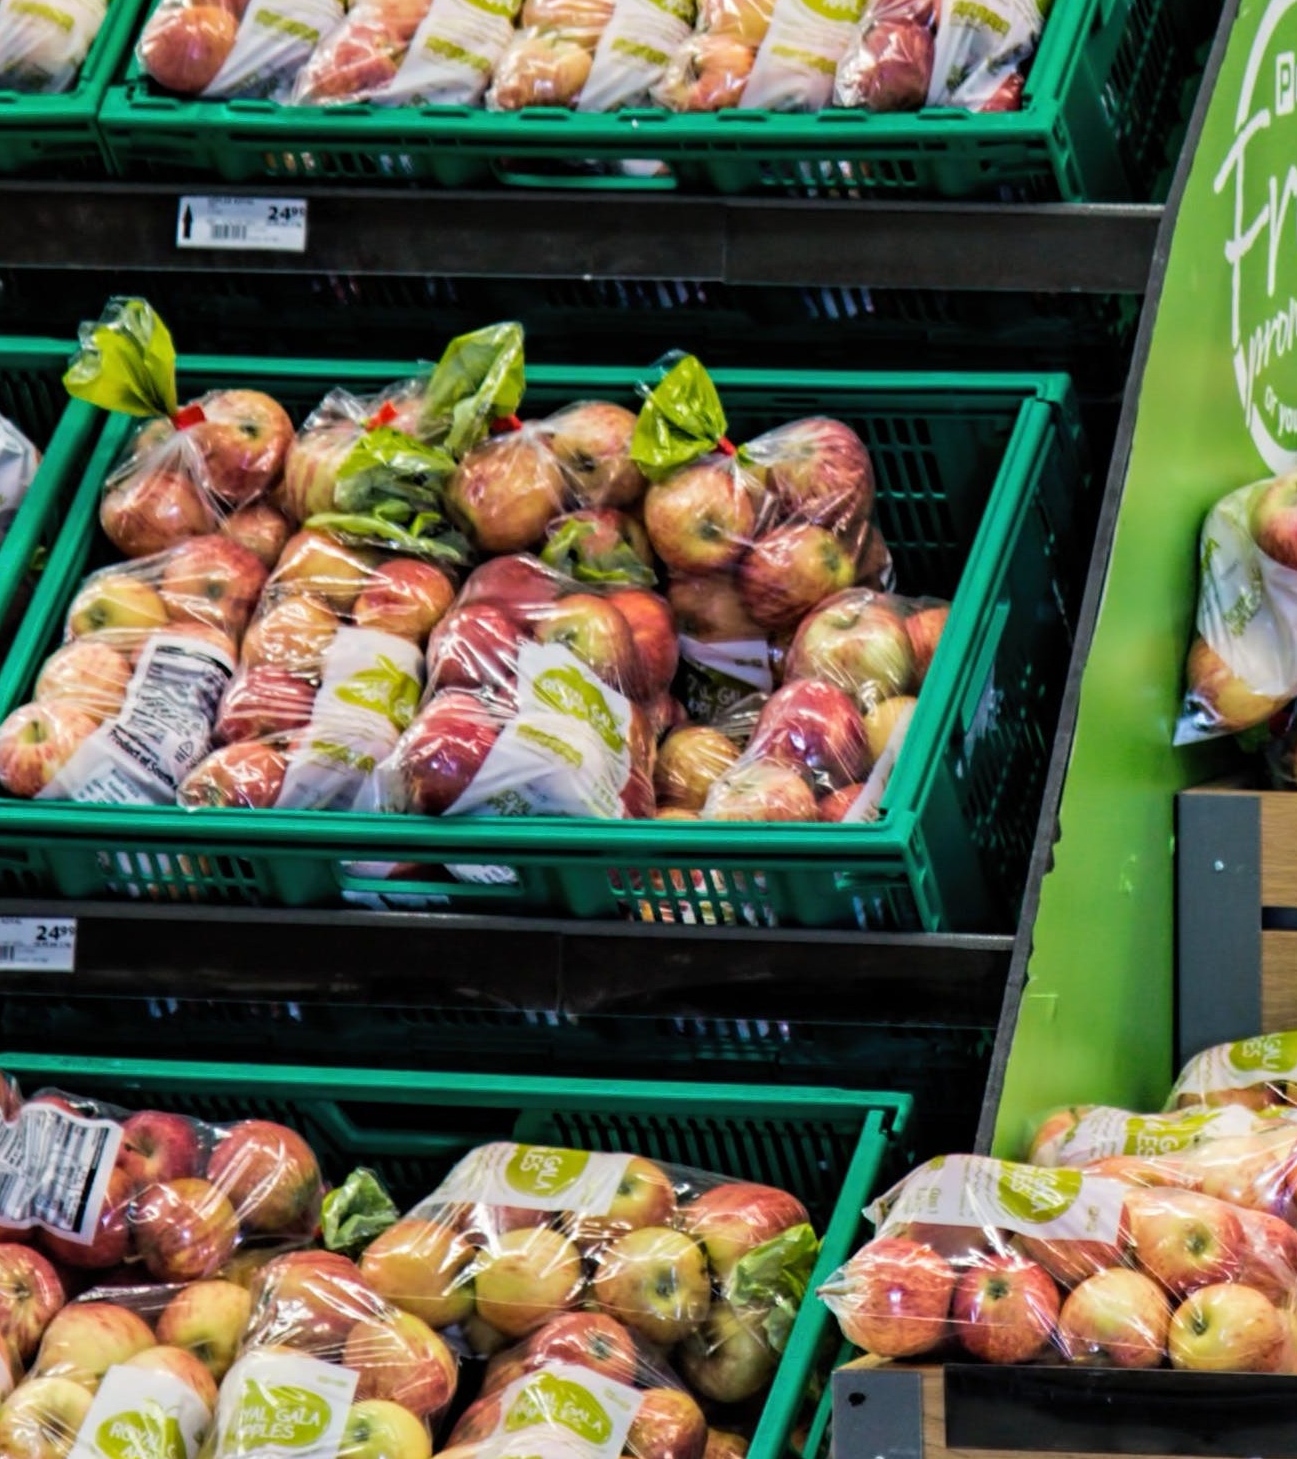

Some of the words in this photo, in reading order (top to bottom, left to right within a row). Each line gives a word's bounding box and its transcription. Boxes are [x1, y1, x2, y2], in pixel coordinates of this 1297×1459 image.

[1264, 383, 1278, 416] or
[110, 728, 141, 759] Product
[275, 1406, 321, 1428] GALA
